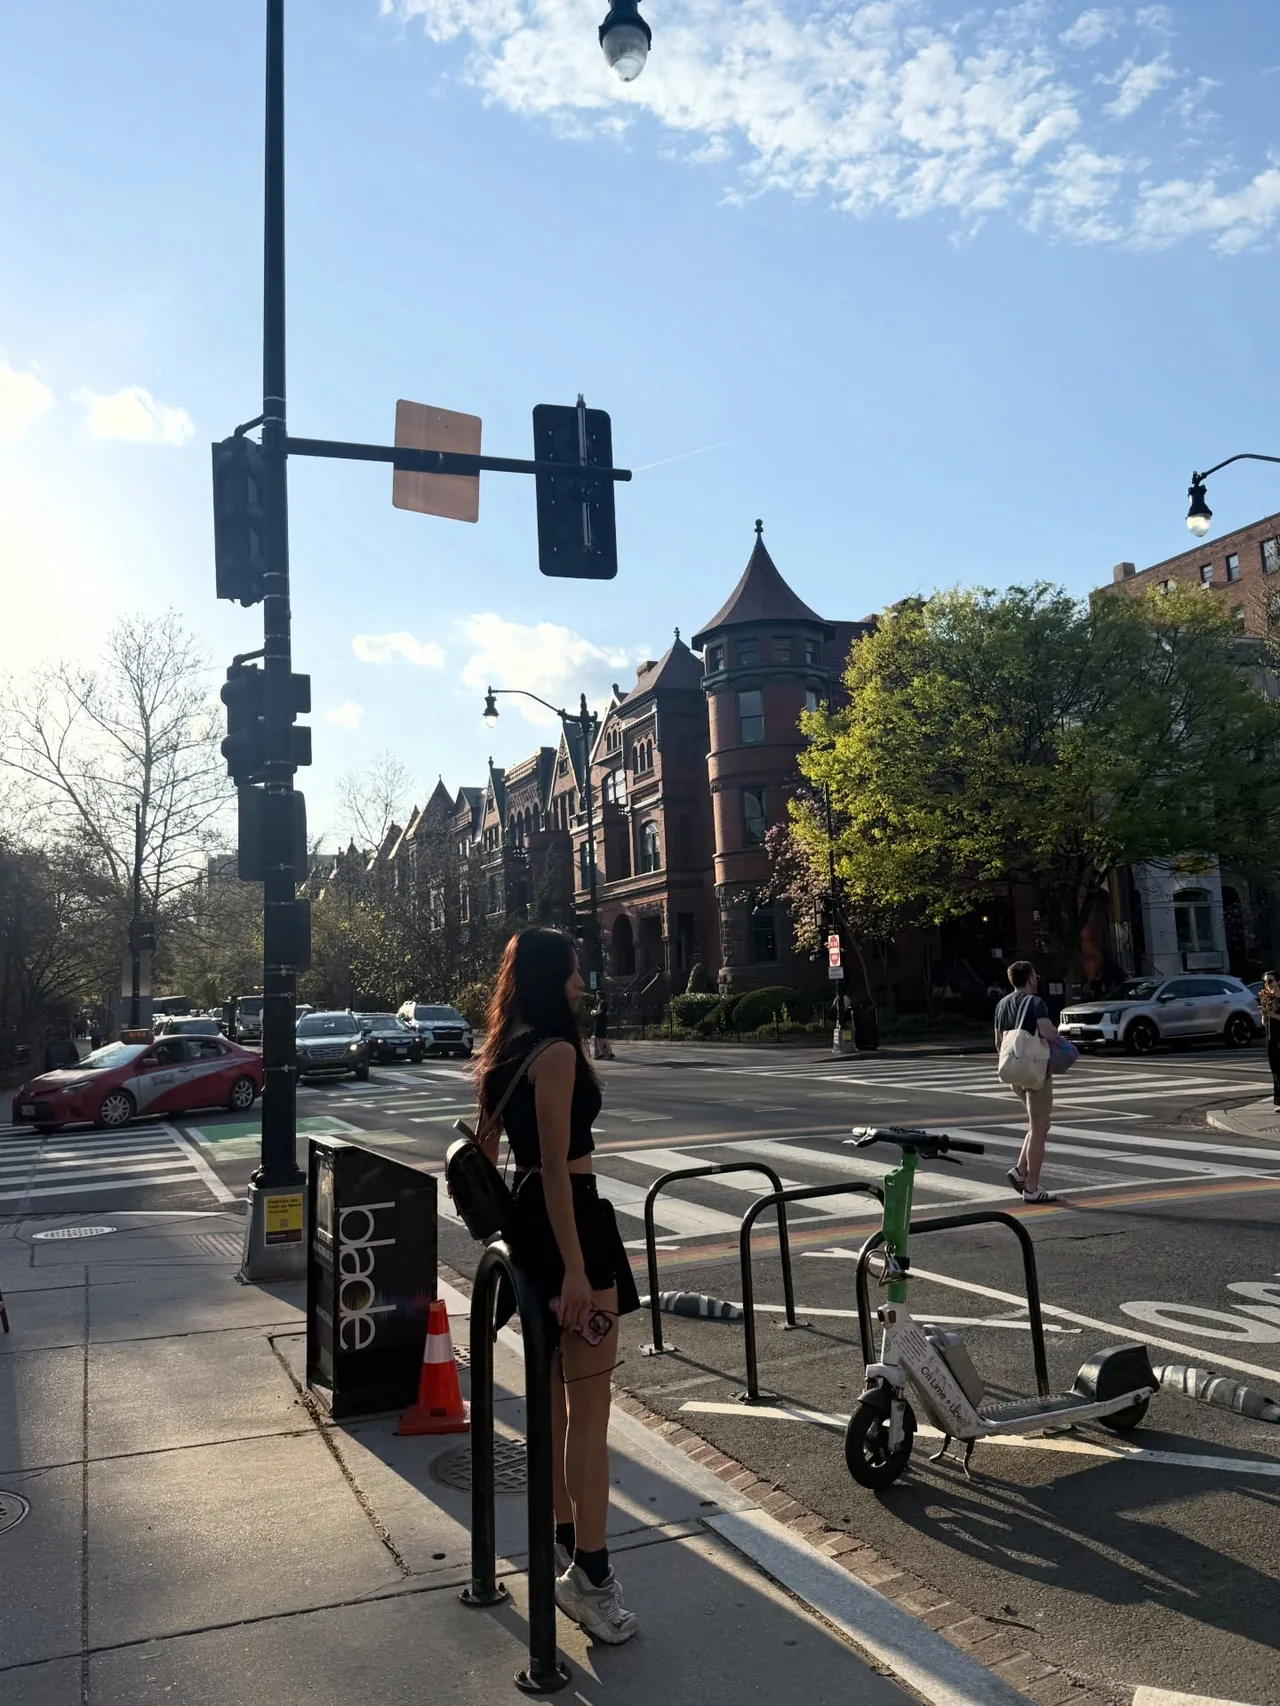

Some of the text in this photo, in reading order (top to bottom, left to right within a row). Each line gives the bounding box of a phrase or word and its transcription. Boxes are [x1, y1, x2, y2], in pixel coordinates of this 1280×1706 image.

[339, 1201, 396, 1350] blade
[921, 1366, 932, 1383] On
[930, 1379, 947, 1400] Lime
